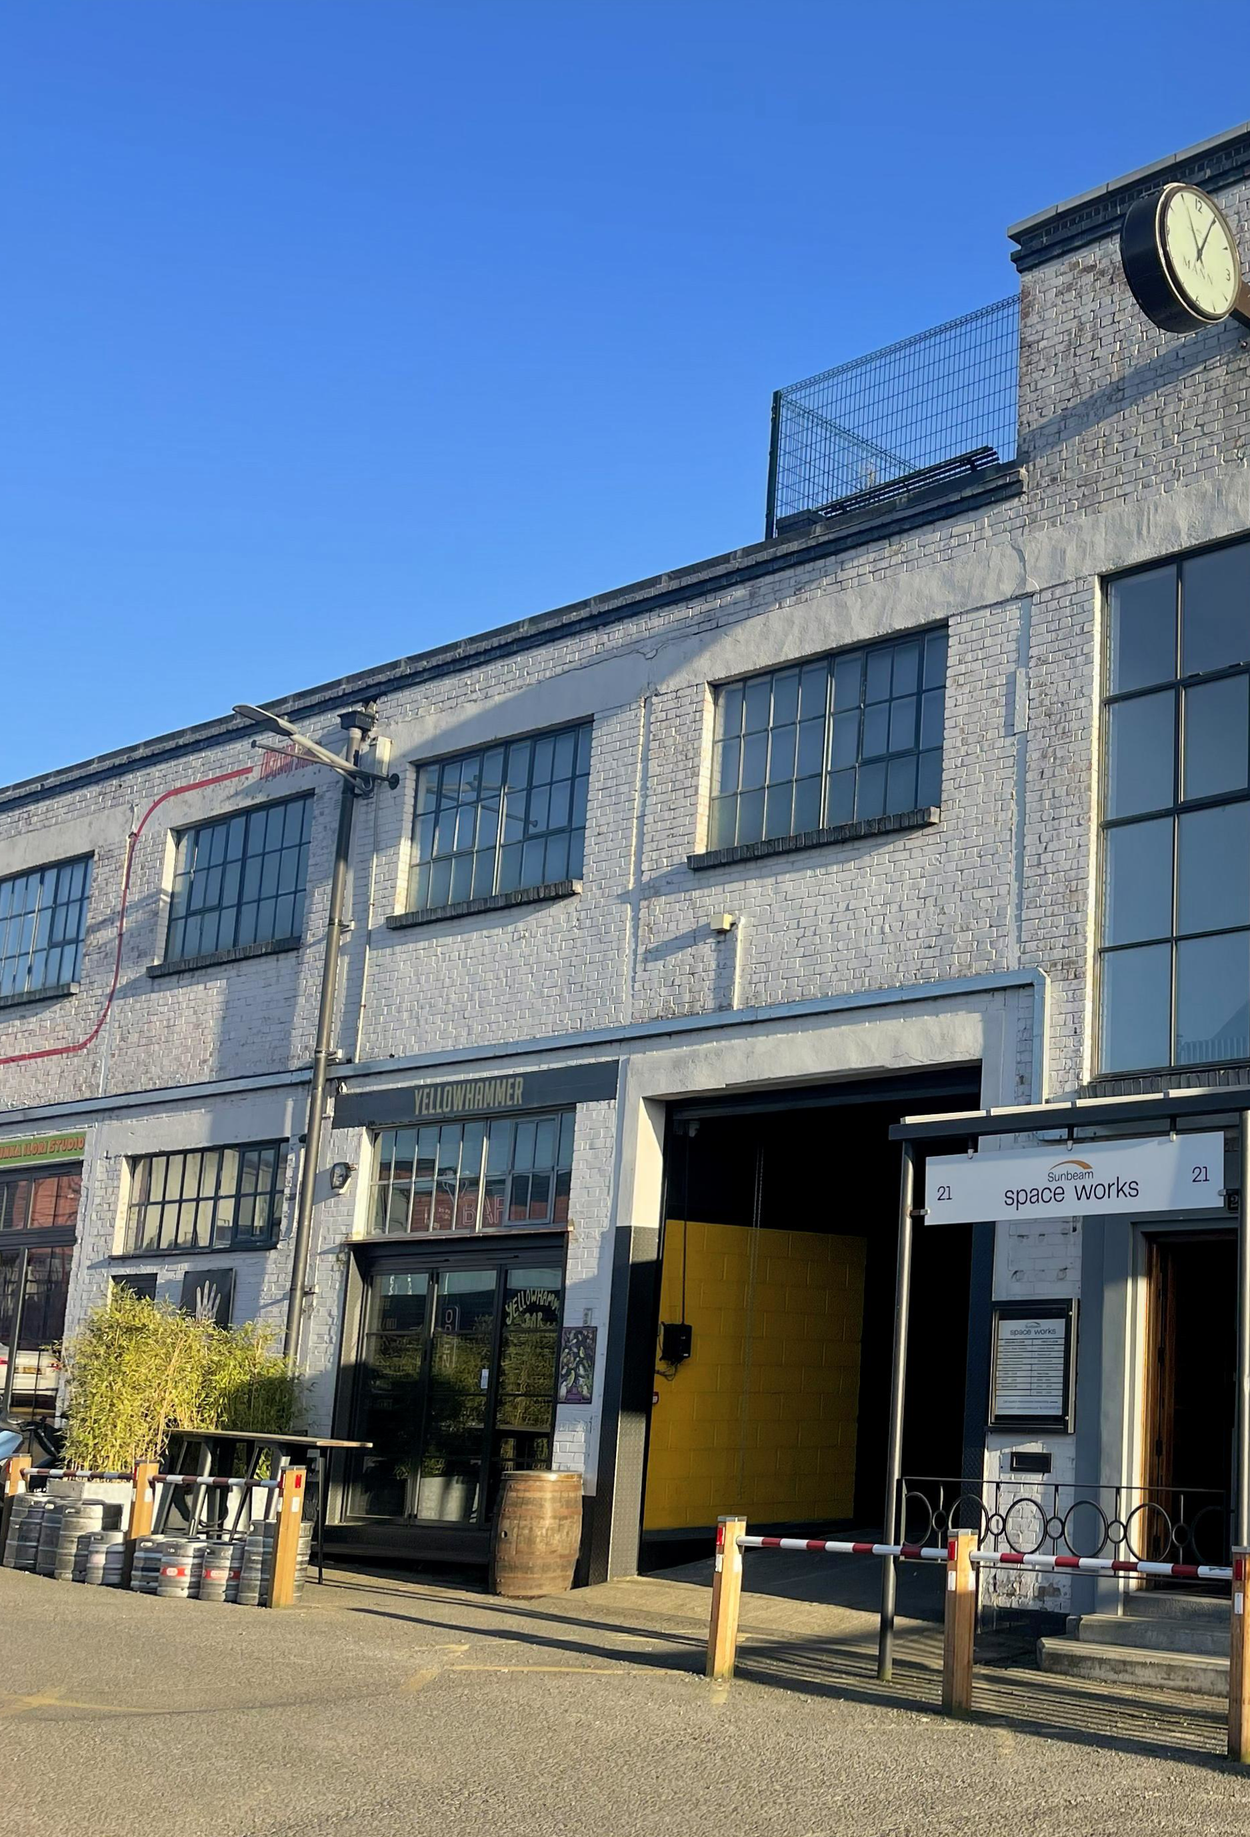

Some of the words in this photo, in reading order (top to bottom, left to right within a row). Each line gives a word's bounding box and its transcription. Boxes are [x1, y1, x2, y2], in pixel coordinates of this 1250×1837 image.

[1195, 198, 1203, 214] 12
[1226, 268, 1231, 282] 3
[414, 1077, 524, 1115] YELLOWHAMMER
[49, 1136, 86, 1153] STUDIO
[1047, 1169, 1094, 1182] Sunbeam
[1191, 1166, 1210, 1183] 21
[937, 1185, 952, 1201] 21
[1004, 1184, 1065, 1211] space
[1075, 1176, 1139, 1202] works
[1230, 1195, 1239, 1208] 2
[505, 1288, 560, 1325] YELLOWHAMM
[523, 1312, 543, 1328] BAR
[1010, 1329, 1031, 1337] space
